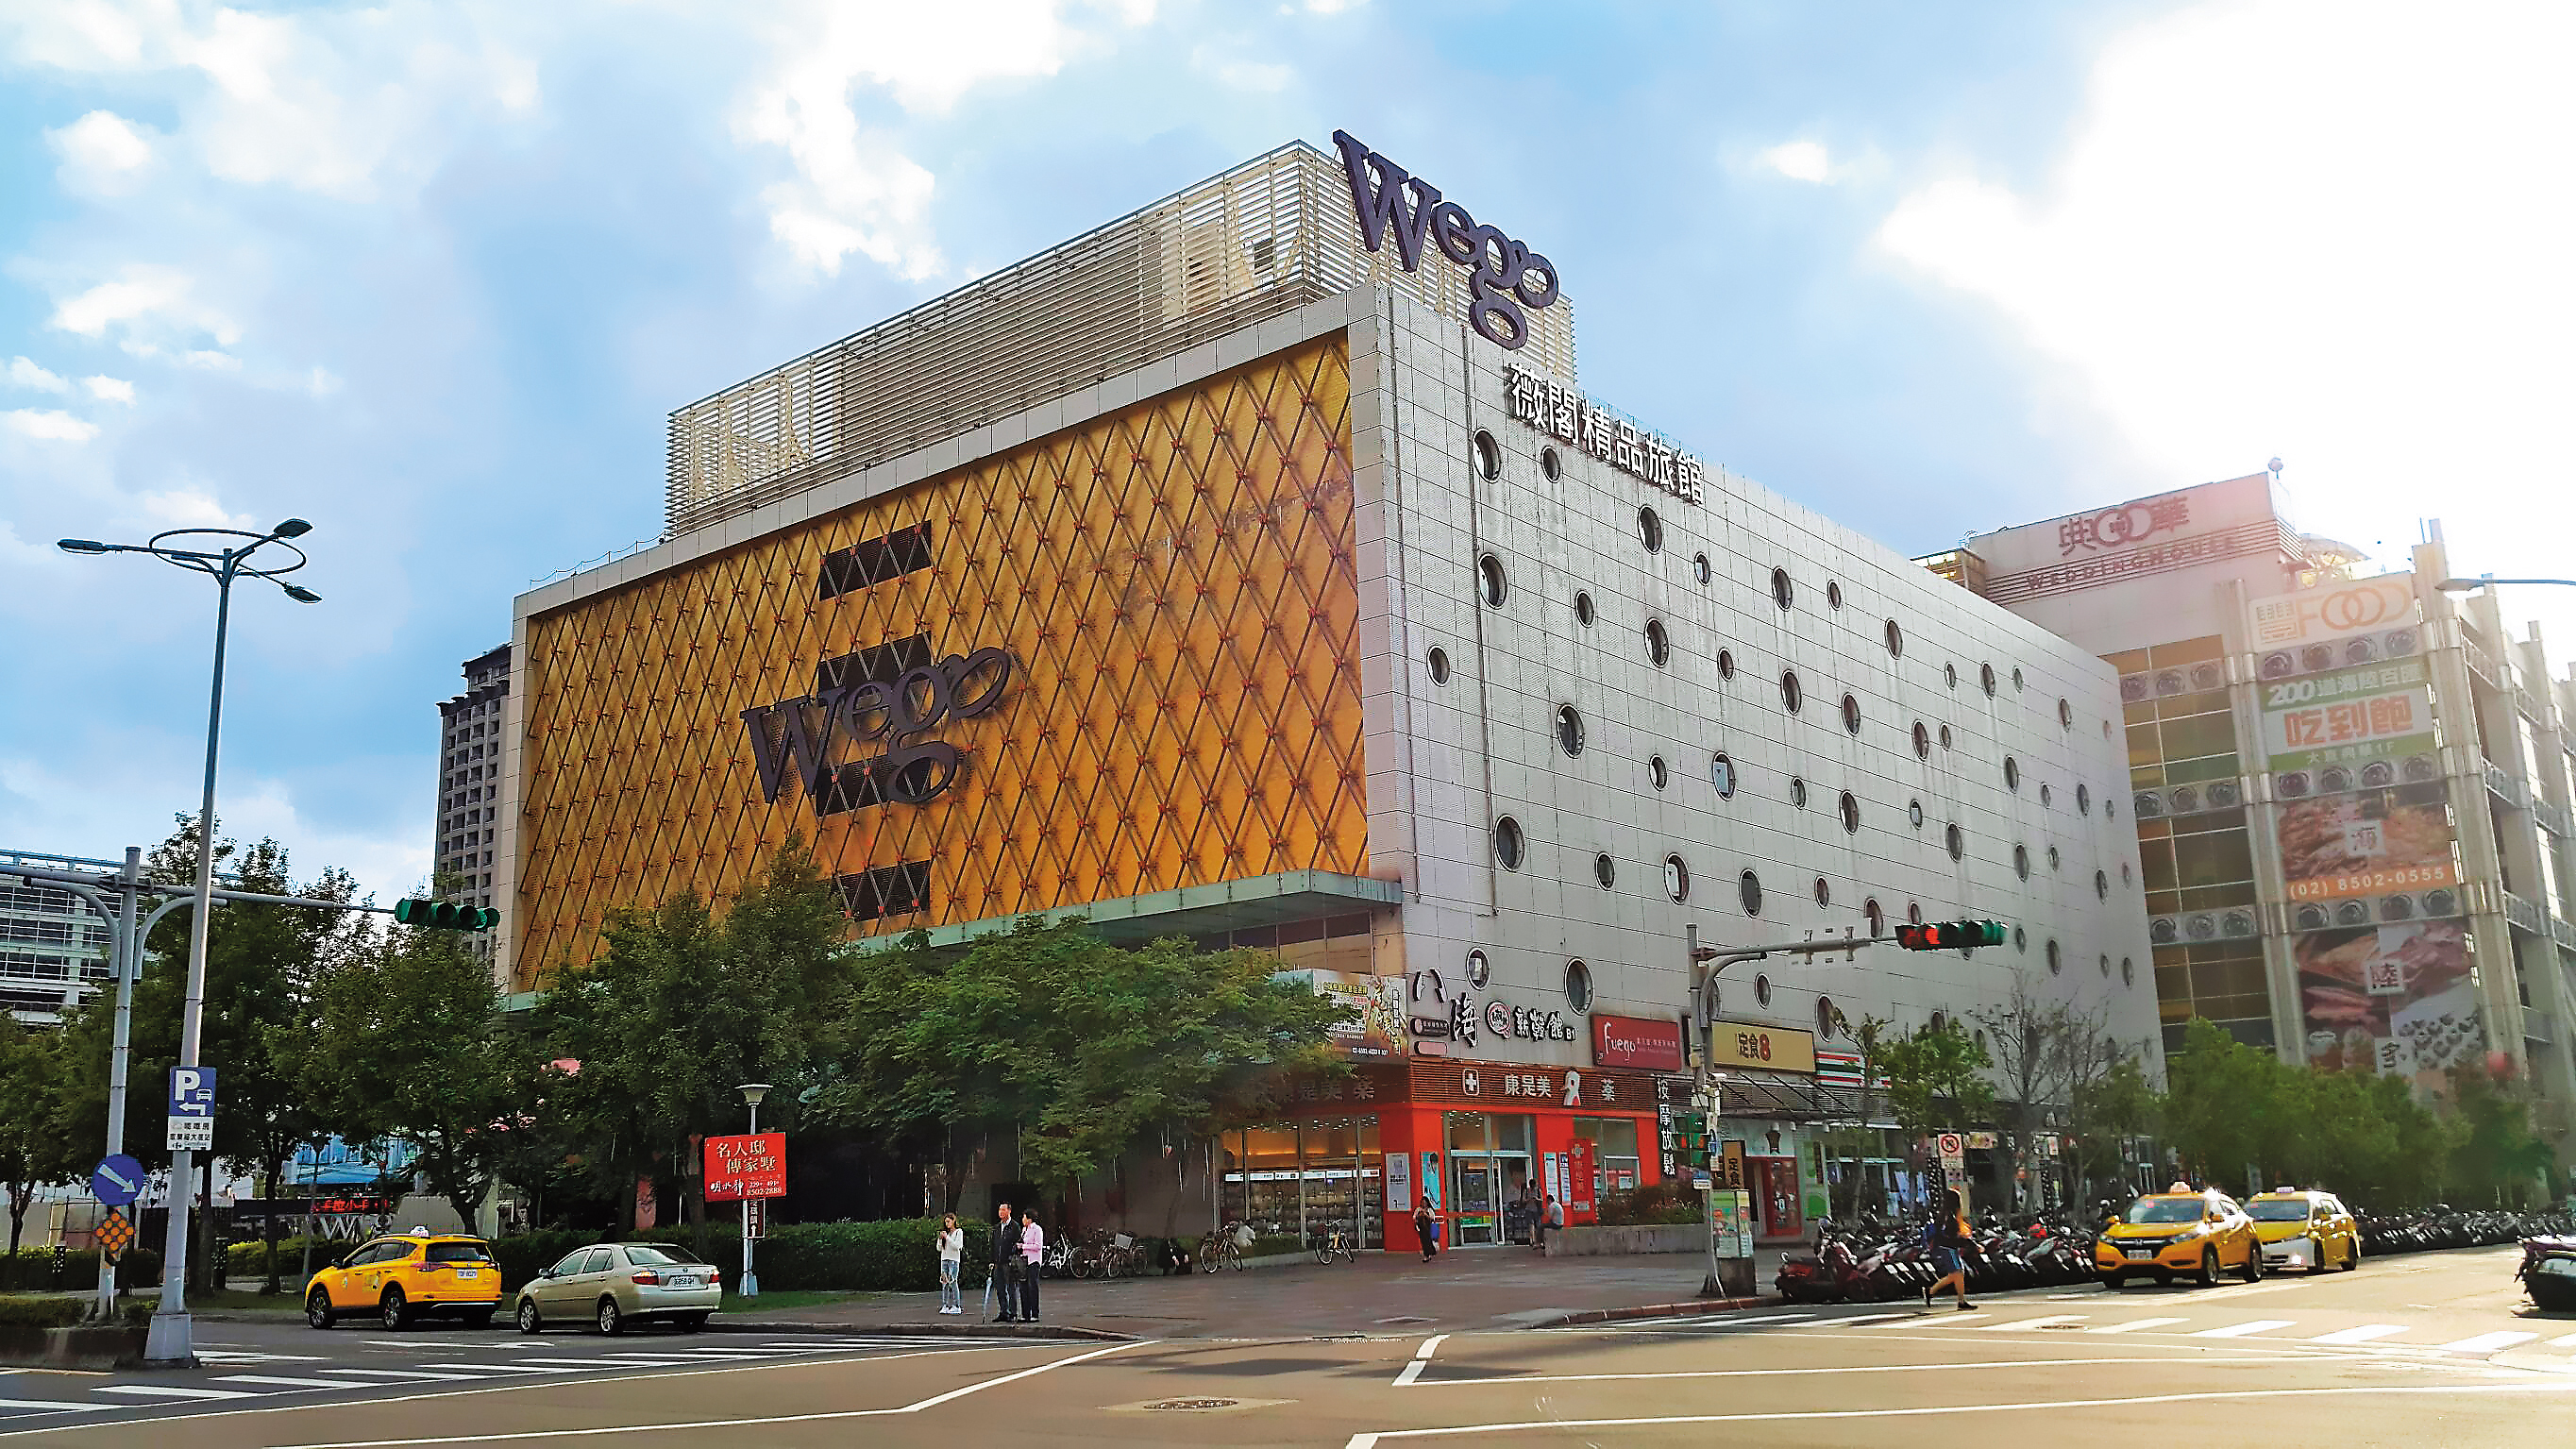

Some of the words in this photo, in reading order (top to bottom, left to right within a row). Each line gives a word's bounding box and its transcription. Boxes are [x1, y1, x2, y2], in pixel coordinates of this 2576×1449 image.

[1332, 128, 1558, 350] Wego
[1510, 368, 1704, 503] 薇閣精品旅館
[739, 647, 1011, 804] Wego
[2284, 695, 2414, 748] 吃到飽
[2290, 880, 2329, 900] (02)
[2337, 868, 2445, 891] 8502-0555
[175, 1070, 200, 1101] P
[1504, 1074, 1552, 1098] 康是美
[716, 1139, 766, 1158] 名人邸
[727, 1156, 776, 1174] 傳家墅
